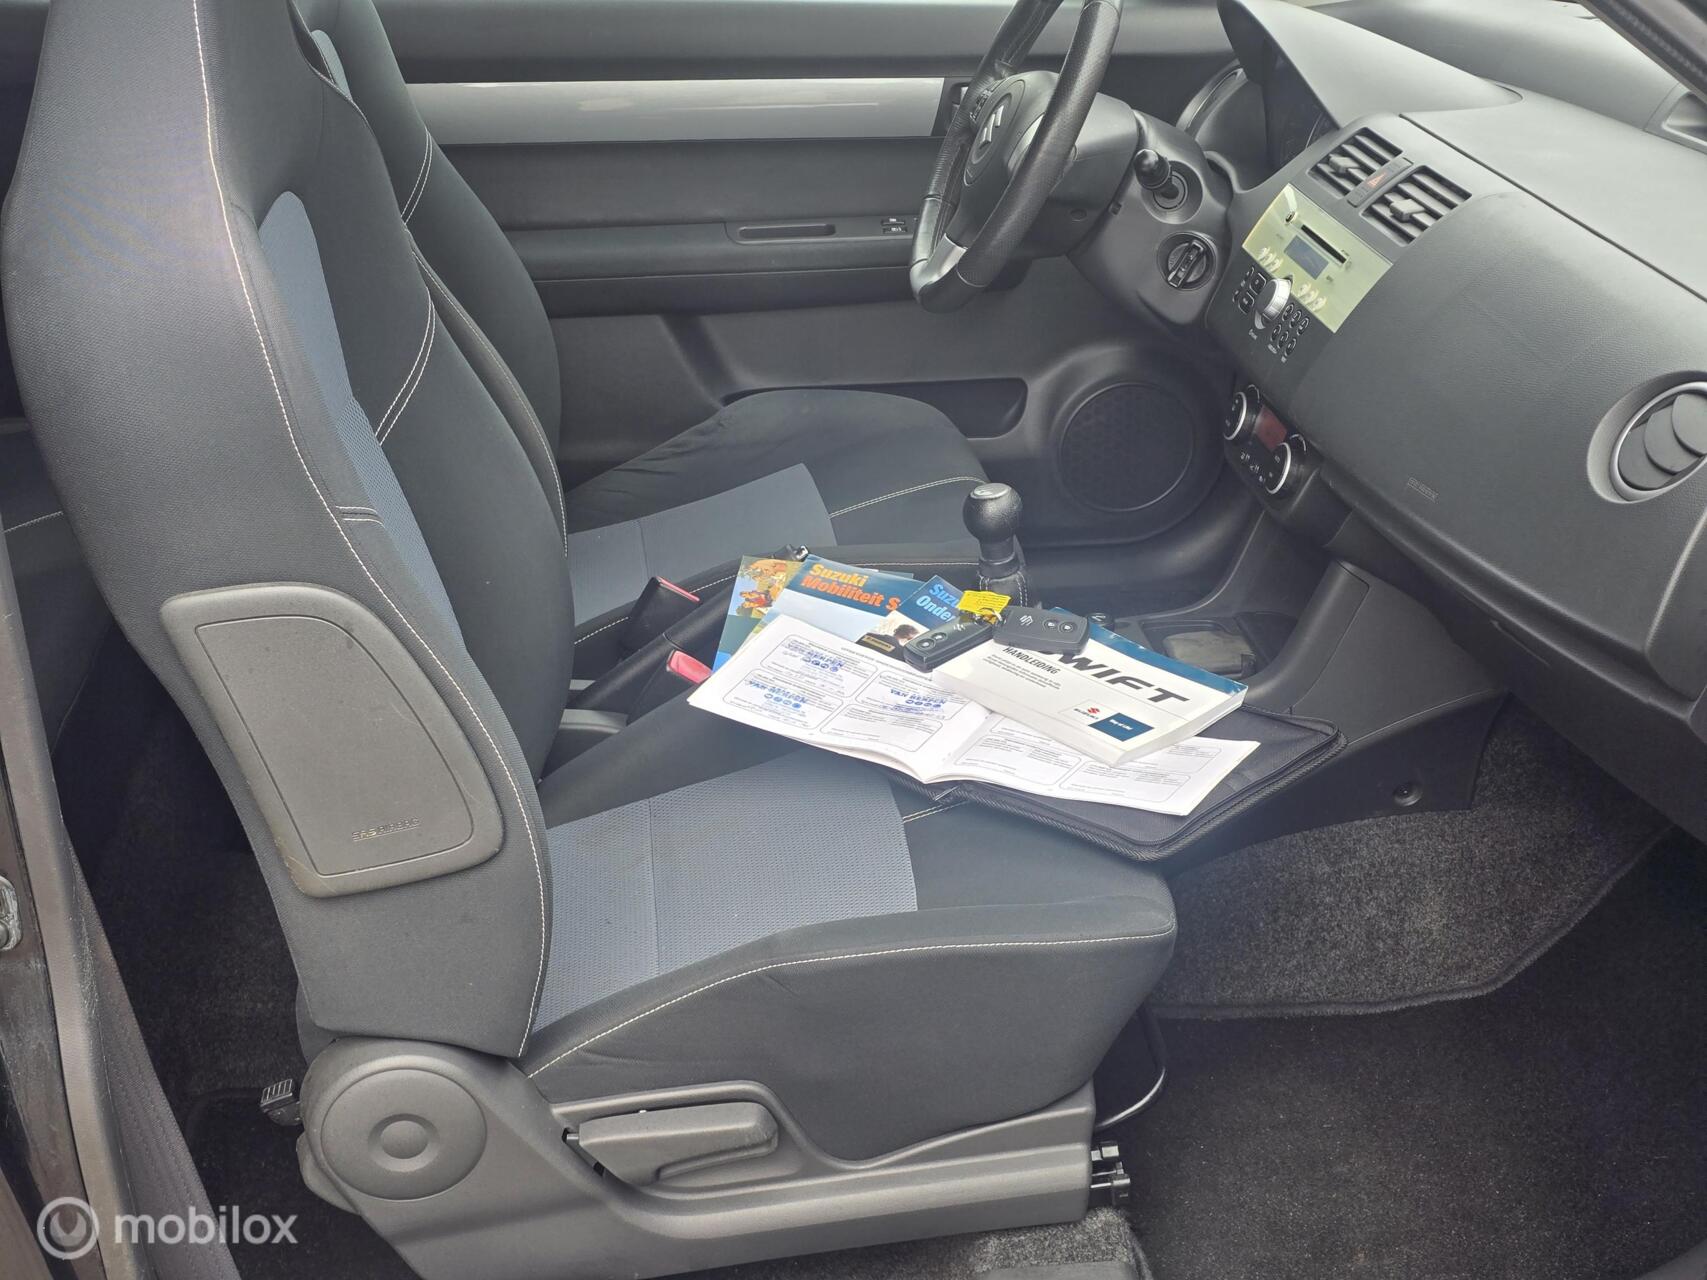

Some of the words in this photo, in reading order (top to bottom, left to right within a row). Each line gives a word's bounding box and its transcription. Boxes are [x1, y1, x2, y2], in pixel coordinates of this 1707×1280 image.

[809, 563, 869, 587] Suzuki
[801, 575, 885, 607] Mobiliteit
[1002, 646, 1061, 675] HANDLEIDING
[1057, 652, 1191, 703] WIFT
